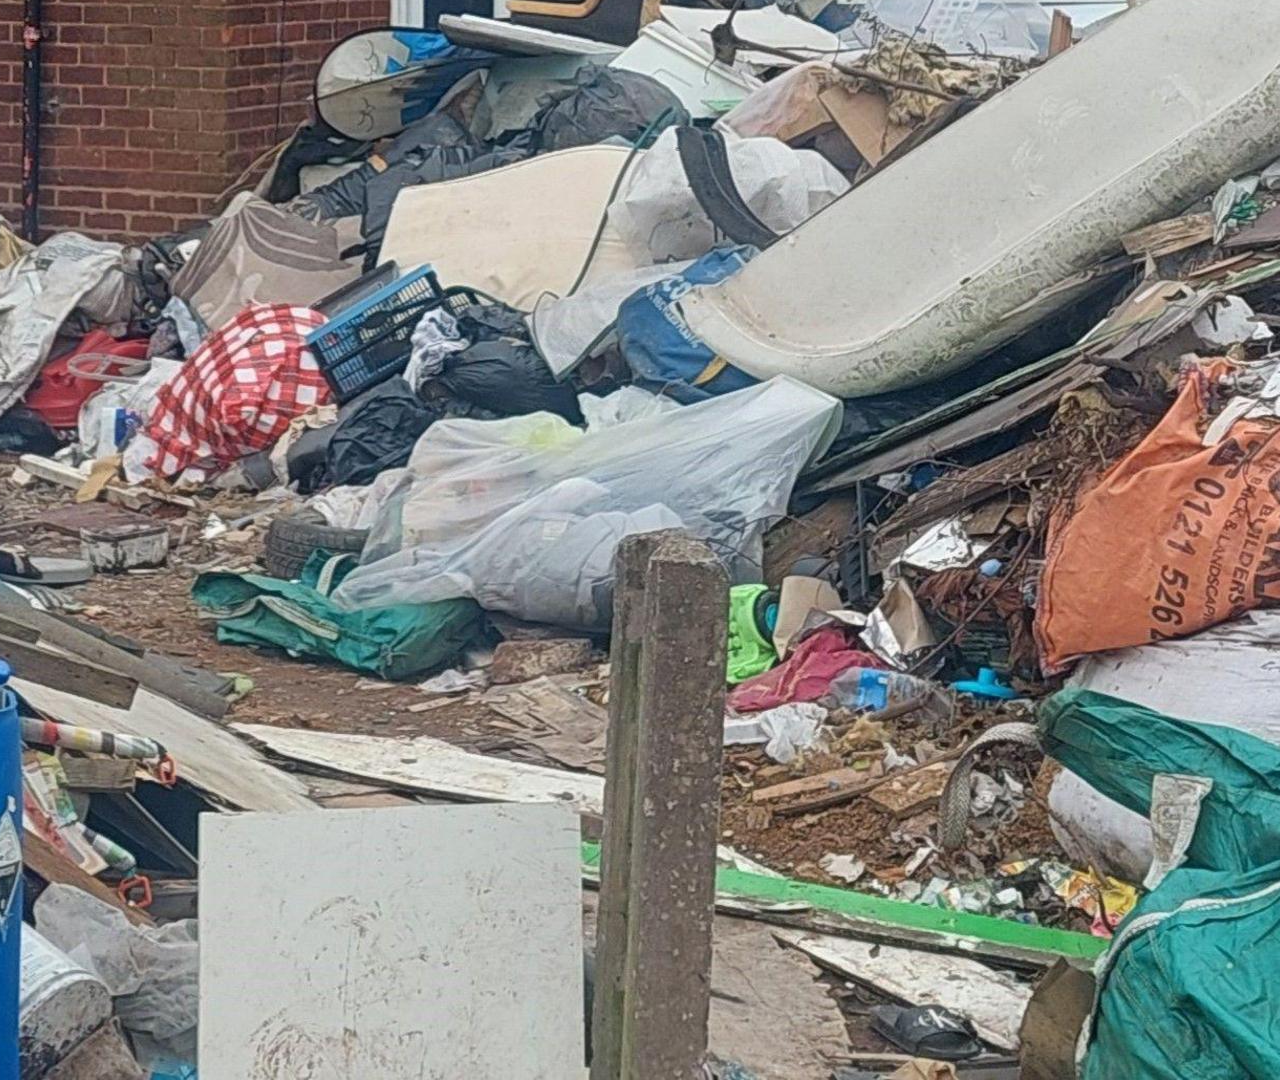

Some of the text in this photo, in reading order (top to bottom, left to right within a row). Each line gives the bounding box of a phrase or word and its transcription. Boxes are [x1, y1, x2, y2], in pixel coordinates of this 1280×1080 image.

[1166, 477, 1225, 556] 0121
[1223, 519, 1238, 531] &
[1227, 504, 1275, 605] BUILDERS
[1151, 565, 1189, 626] 526
[1202, 533, 1231, 620] LANDSCAPI
